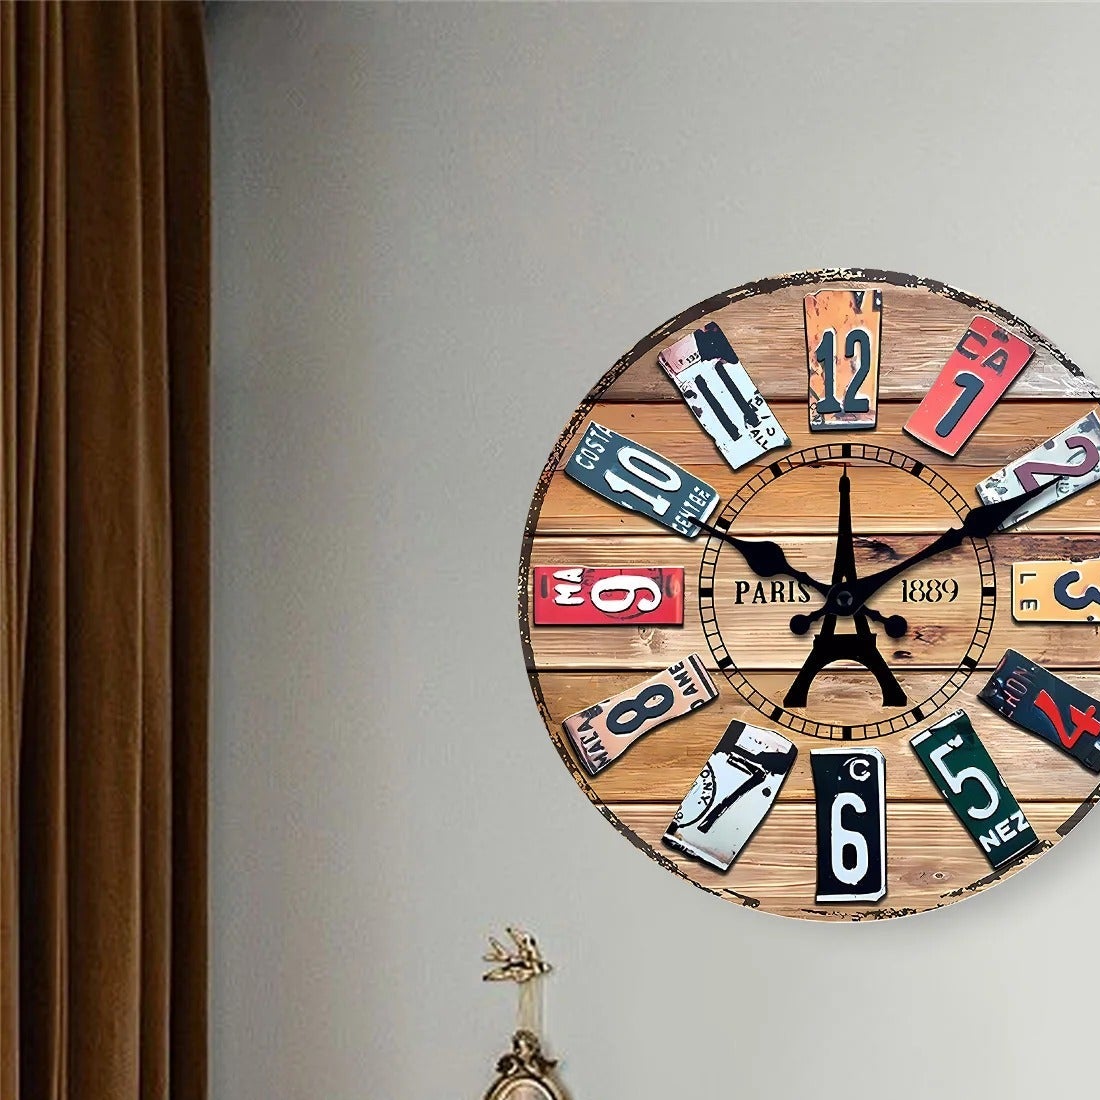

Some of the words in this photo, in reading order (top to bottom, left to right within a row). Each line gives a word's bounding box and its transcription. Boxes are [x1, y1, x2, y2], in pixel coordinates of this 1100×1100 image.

[815, 329, 870, 414] 12
[694, 361, 761, 442] 11
[935, 372, 985, 438] 1
[575, 424, 614, 470] COSTA
[1012, 435, 1100, 494] 2
[603, 445, 682, 516] 10
[552, 567, 585, 606] MA
[589, 575, 663, 613] 9
[734, 580, 812, 605] PARIS
[901, 579, 959, 603] 1889
[606, 683, 675, 736] 8
[697, 752, 768, 834] 7
[929, 734, 1001, 820] 5
[830, 791, 869, 885] 6
[978, 810, 1031, 855] NEZ
